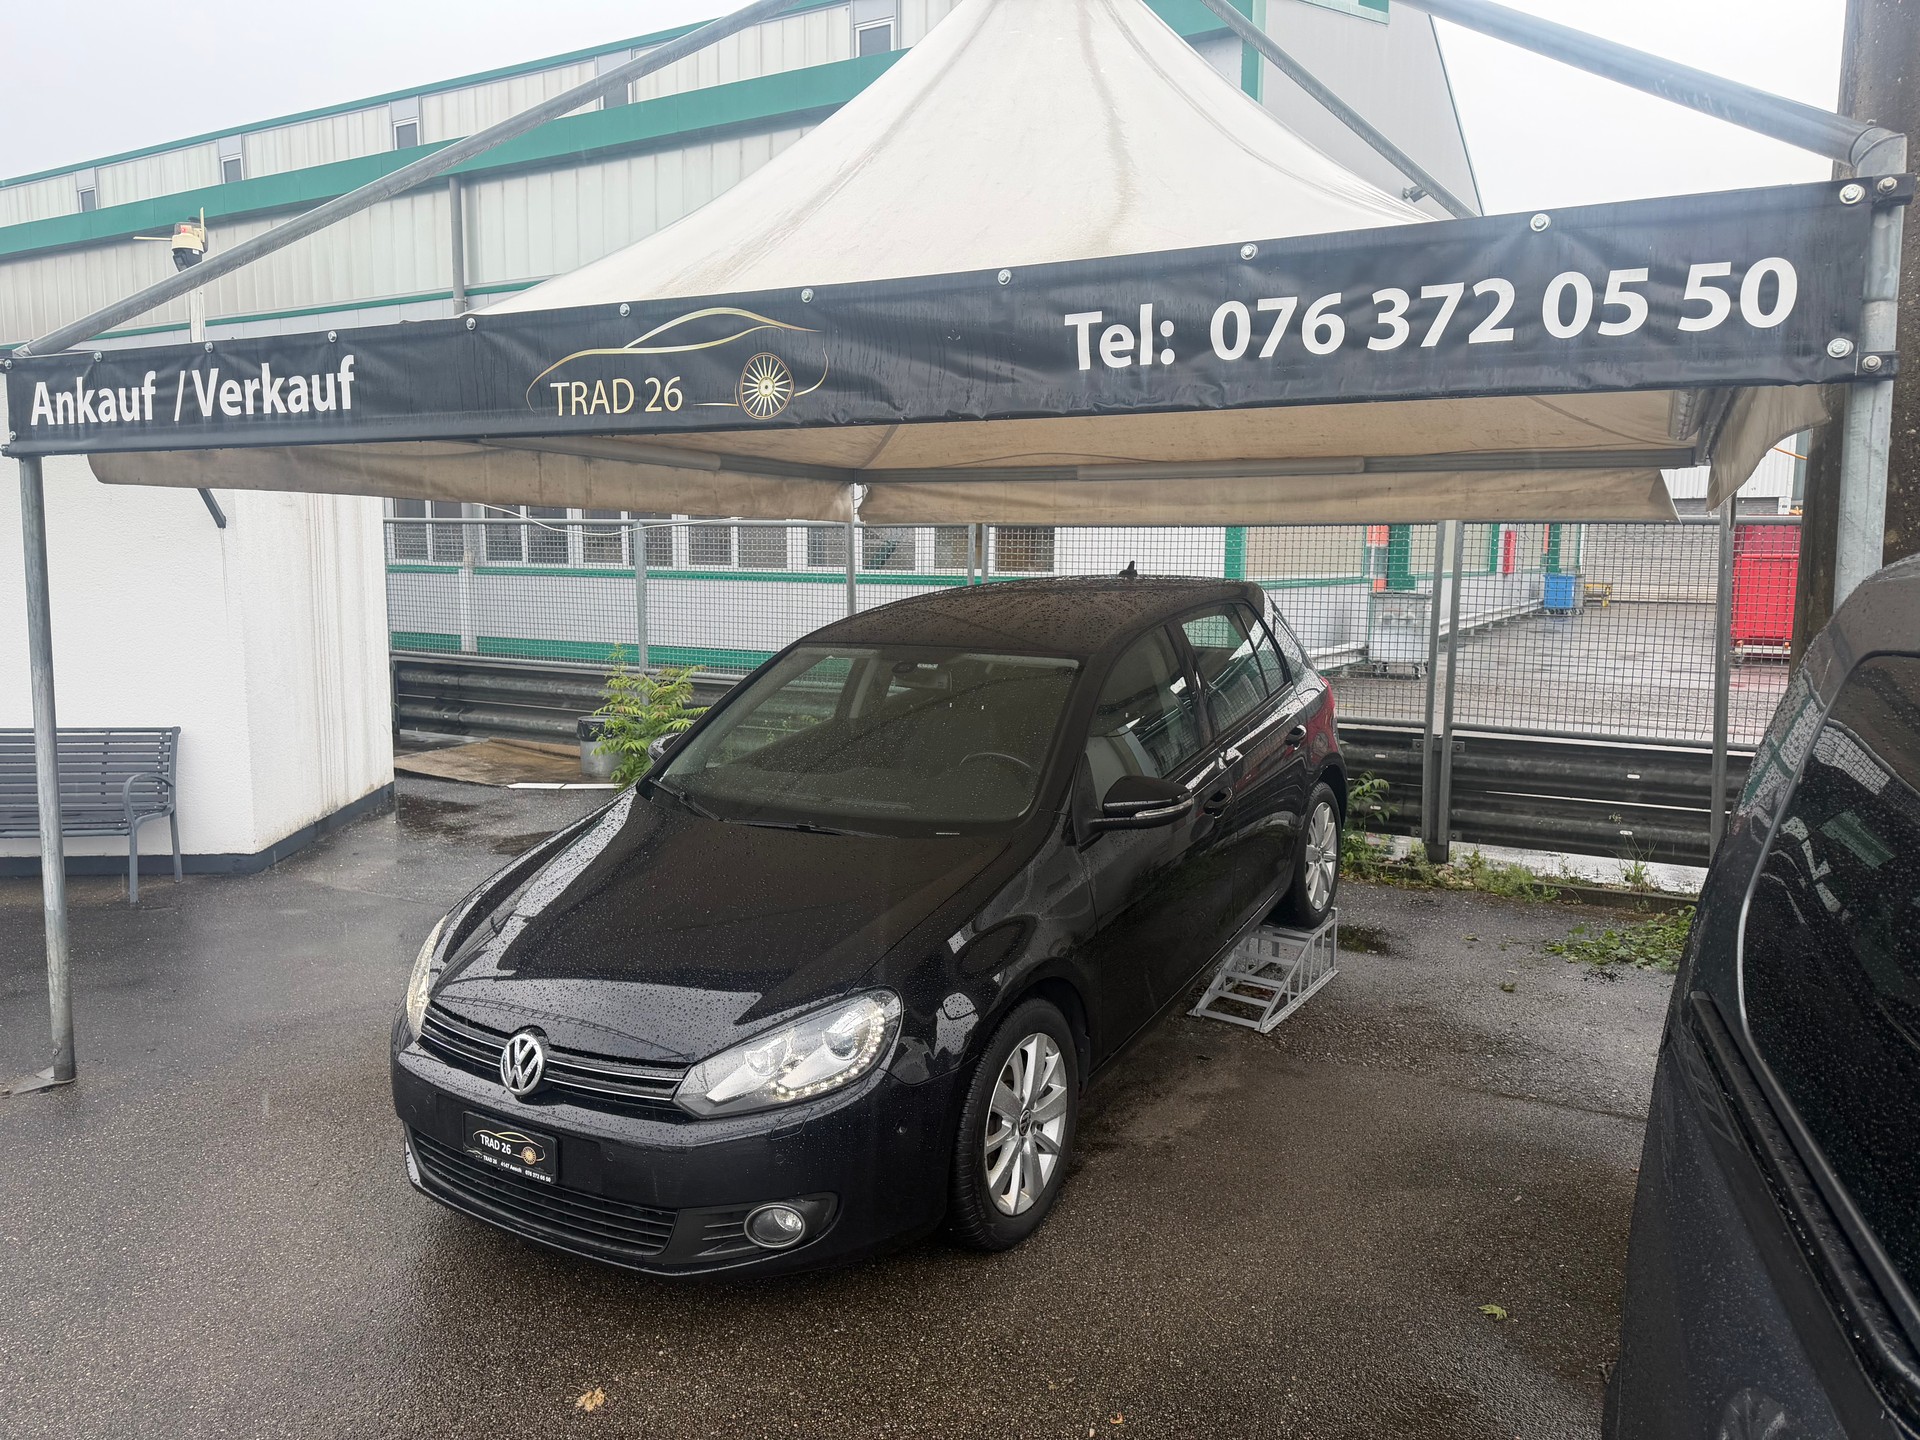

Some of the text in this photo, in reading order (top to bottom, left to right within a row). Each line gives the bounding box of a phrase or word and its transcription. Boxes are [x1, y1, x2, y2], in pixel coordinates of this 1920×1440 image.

[1063, 256, 1798, 371] Tel: 076 372 05 50
[30, 370, 157, 426] Ankauf
[550, 376, 683, 417] TRAD 26
[480, 1134, 511, 1154] TRAD 26
